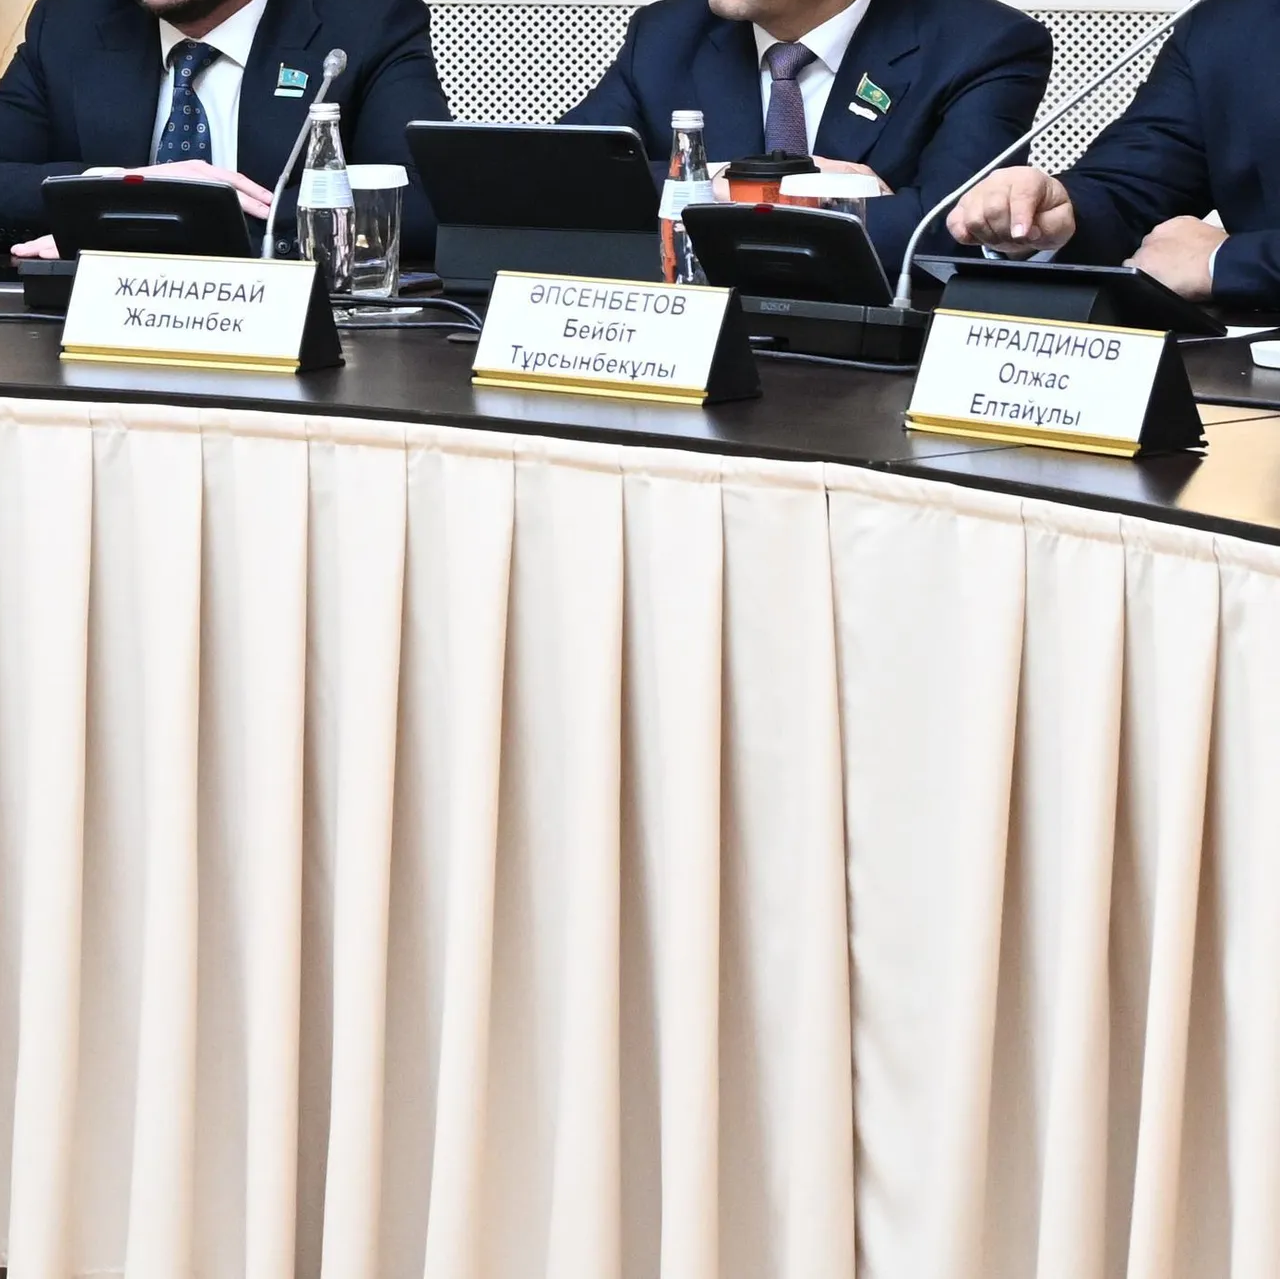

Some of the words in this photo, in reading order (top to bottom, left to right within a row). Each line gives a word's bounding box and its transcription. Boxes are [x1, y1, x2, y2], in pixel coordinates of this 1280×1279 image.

[115, 274, 265, 304] ЖАЙНАРБАЙ
[530, 284, 687, 316] ӘПСЕНБЕТОВ
[124, 307, 244, 333] Жалынбек
[760, 302, 790, 311] BOSCH
[563, 319, 637, 343] Бейбіт
[966, 325, 1122, 361] НҰРАЛДИНОВ
[510, 344, 676, 379] Тұрсынбекұлы
[999, 363, 1070, 390] Олжас
[970, 394, 1081, 427] Елтайұлы
